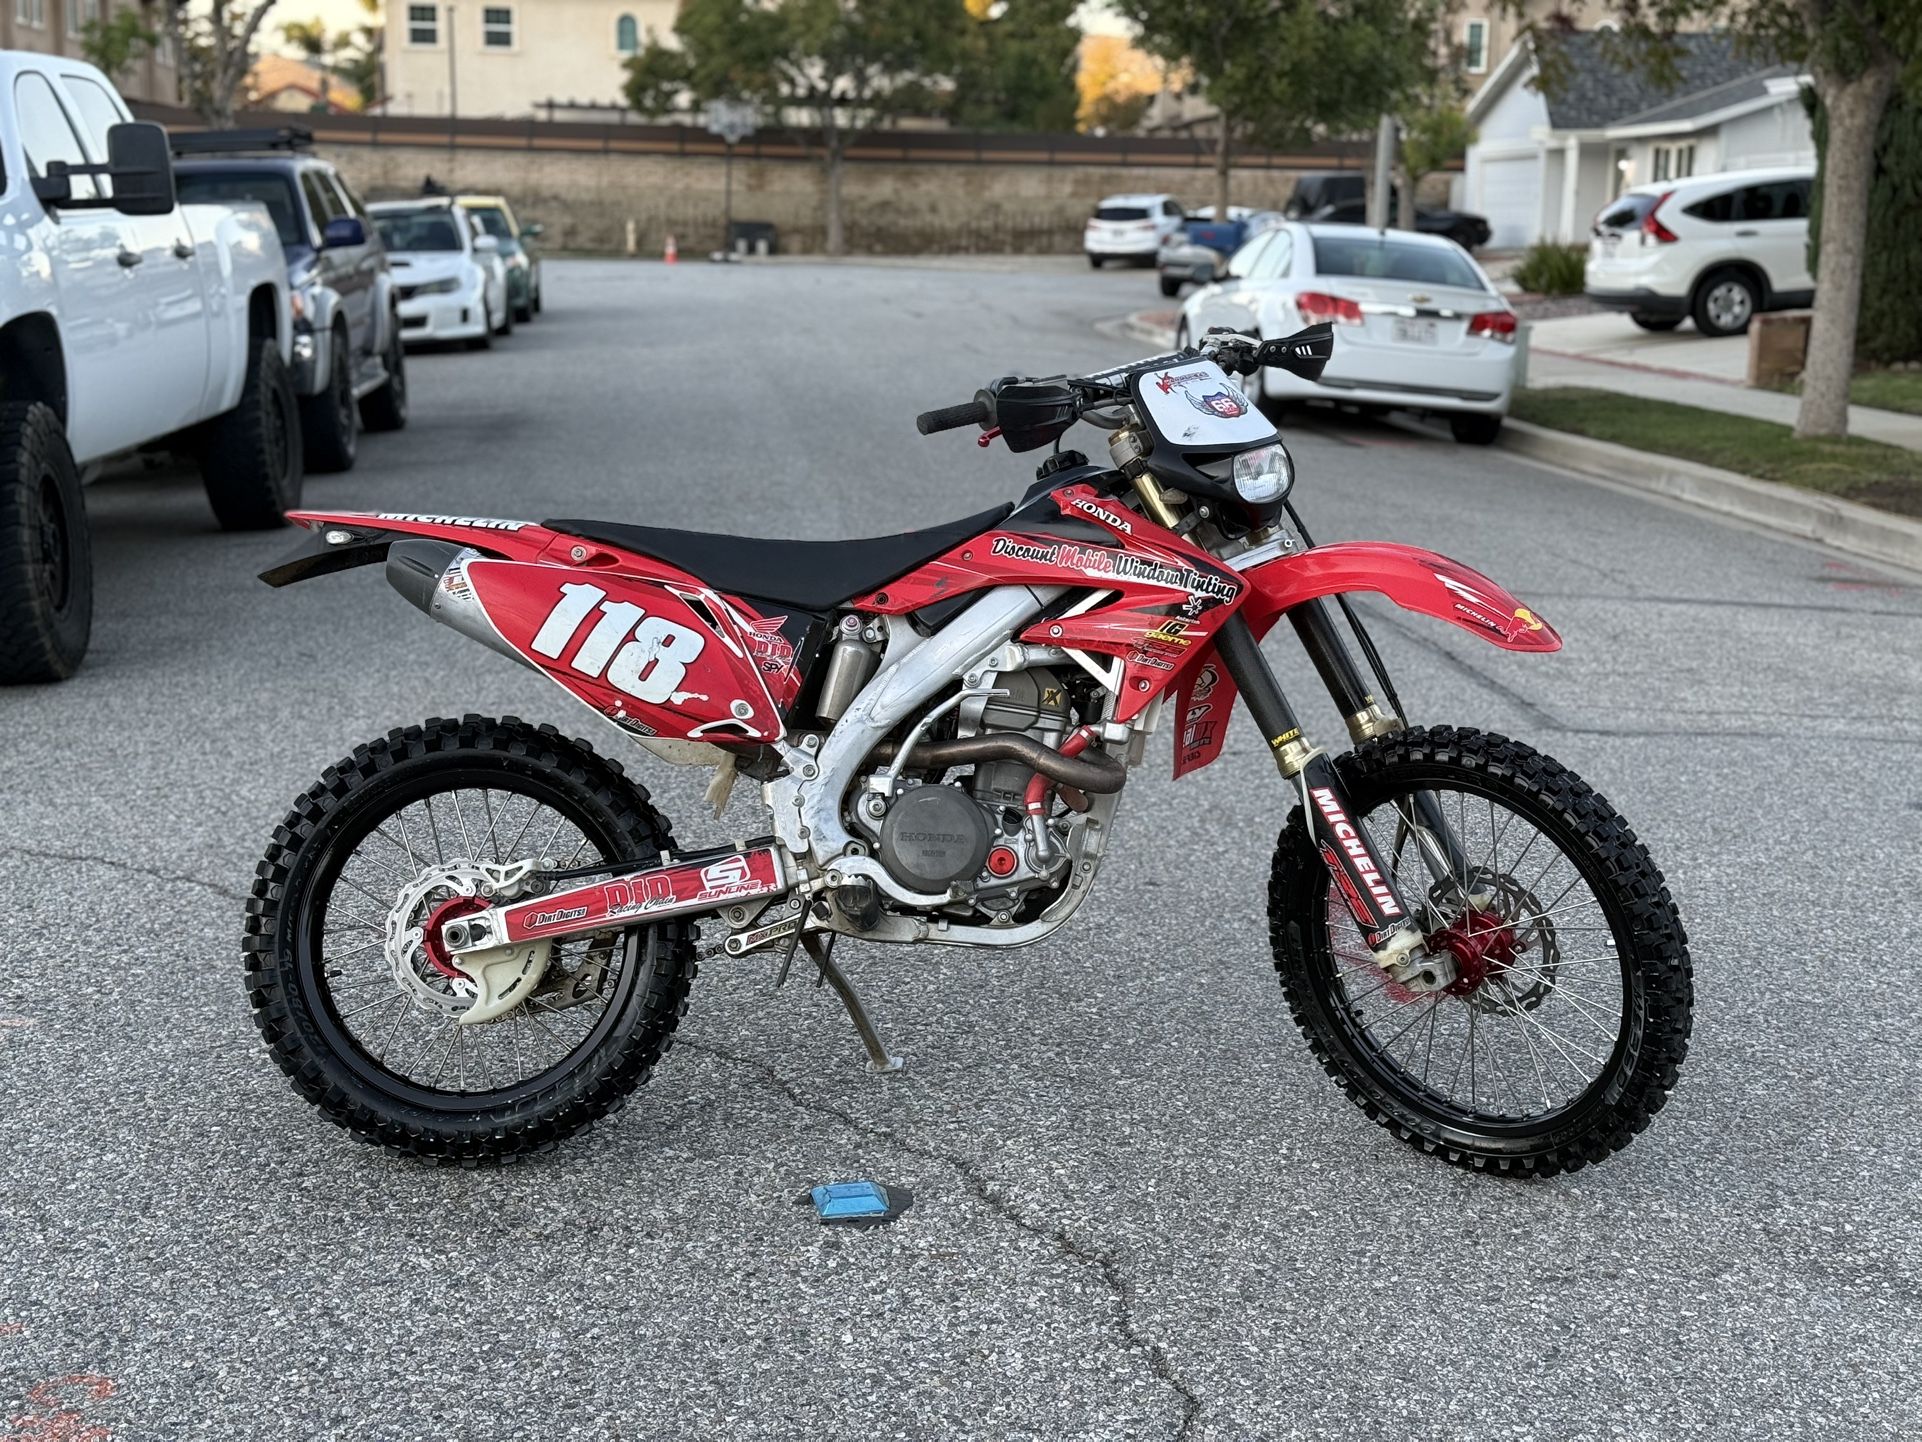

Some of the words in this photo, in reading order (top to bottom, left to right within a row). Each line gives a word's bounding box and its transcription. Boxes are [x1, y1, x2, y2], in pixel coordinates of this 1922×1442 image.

[378, 513, 522, 531] MICHELIN
[1069, 498, 1133, 537] HONDA
[992, 537, 1057, 565] Discount
[1058, 545, 1113, 573] Mobile
[1116, 555, 1184, 586] Window
[1185, 568, 1236, 603] Tinting
[1454, 603, 1496, 627] MICHELIN
[531, 581, 705, 704] 118
[749, 631, 783, 642] HONDA
[762, 661, 785, 673] SPY
[900, 831, 967, 843] HONDA
[1311, 787, 1401, 916] MICHELIN
[697, 880, 761, 900] SUNLINE
[608, 903, 642, 918] Racing
[645, 896, 675, 910] Chain
